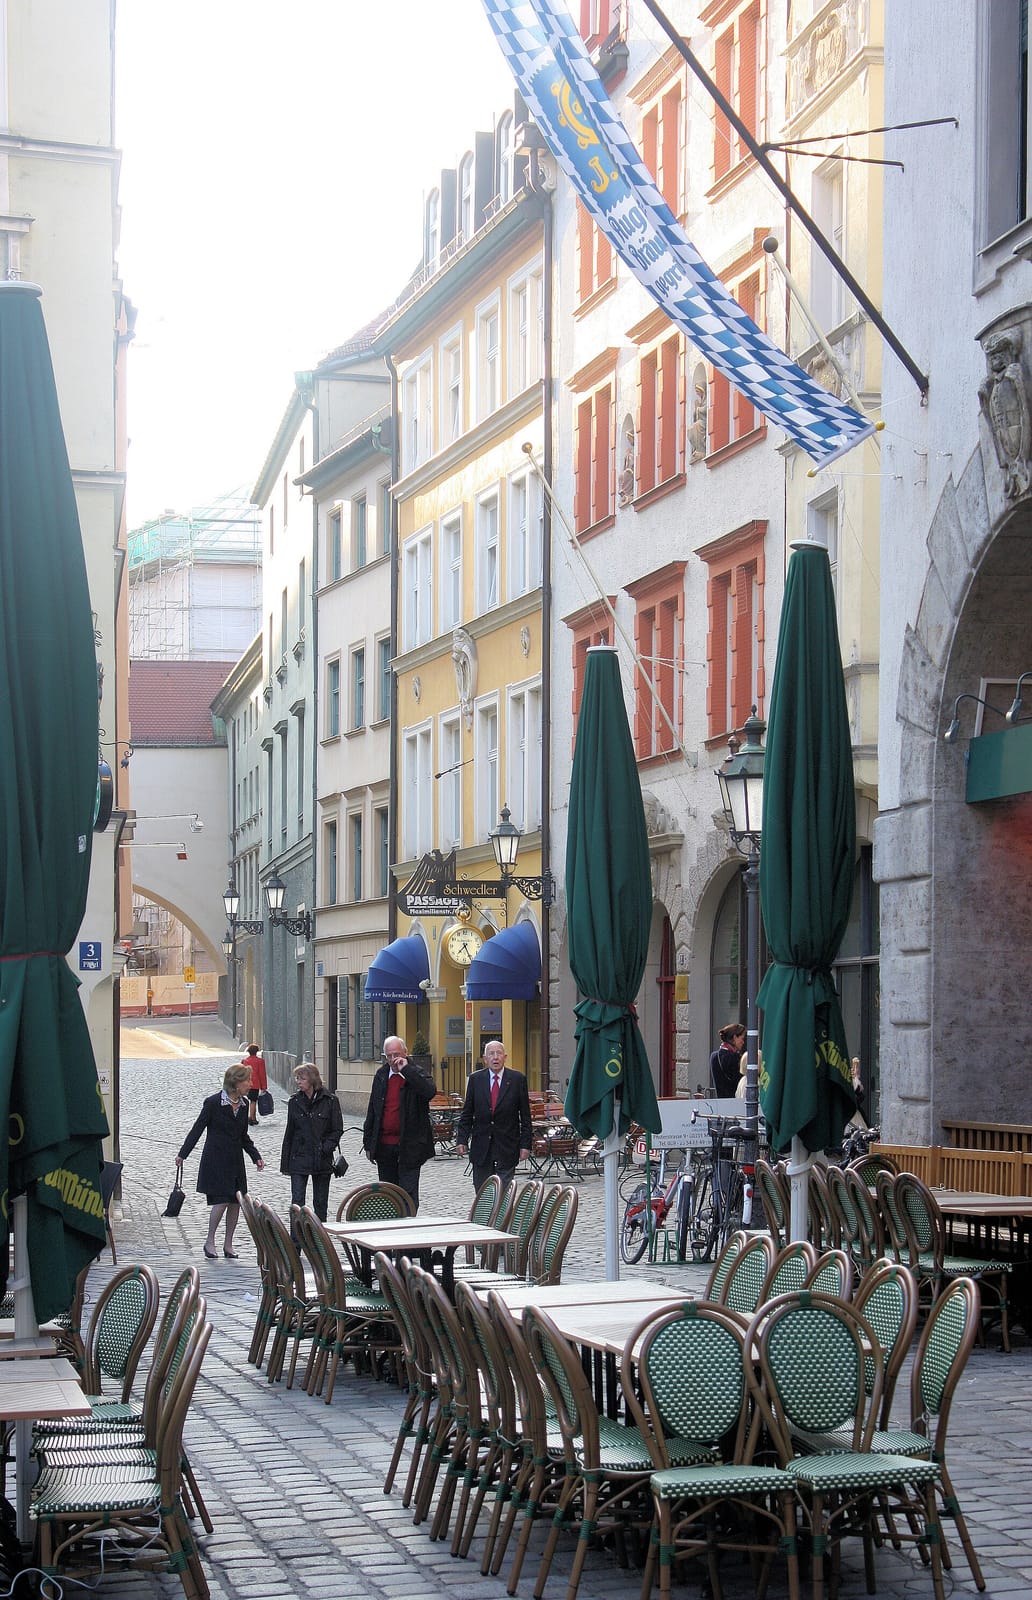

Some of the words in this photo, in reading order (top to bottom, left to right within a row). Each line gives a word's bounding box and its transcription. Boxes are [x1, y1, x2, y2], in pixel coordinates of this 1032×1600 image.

[443, 884, 498, 896] Schwedler
[86, 943, 95, 957] 3
[639, 1142, 655, 1154] D
